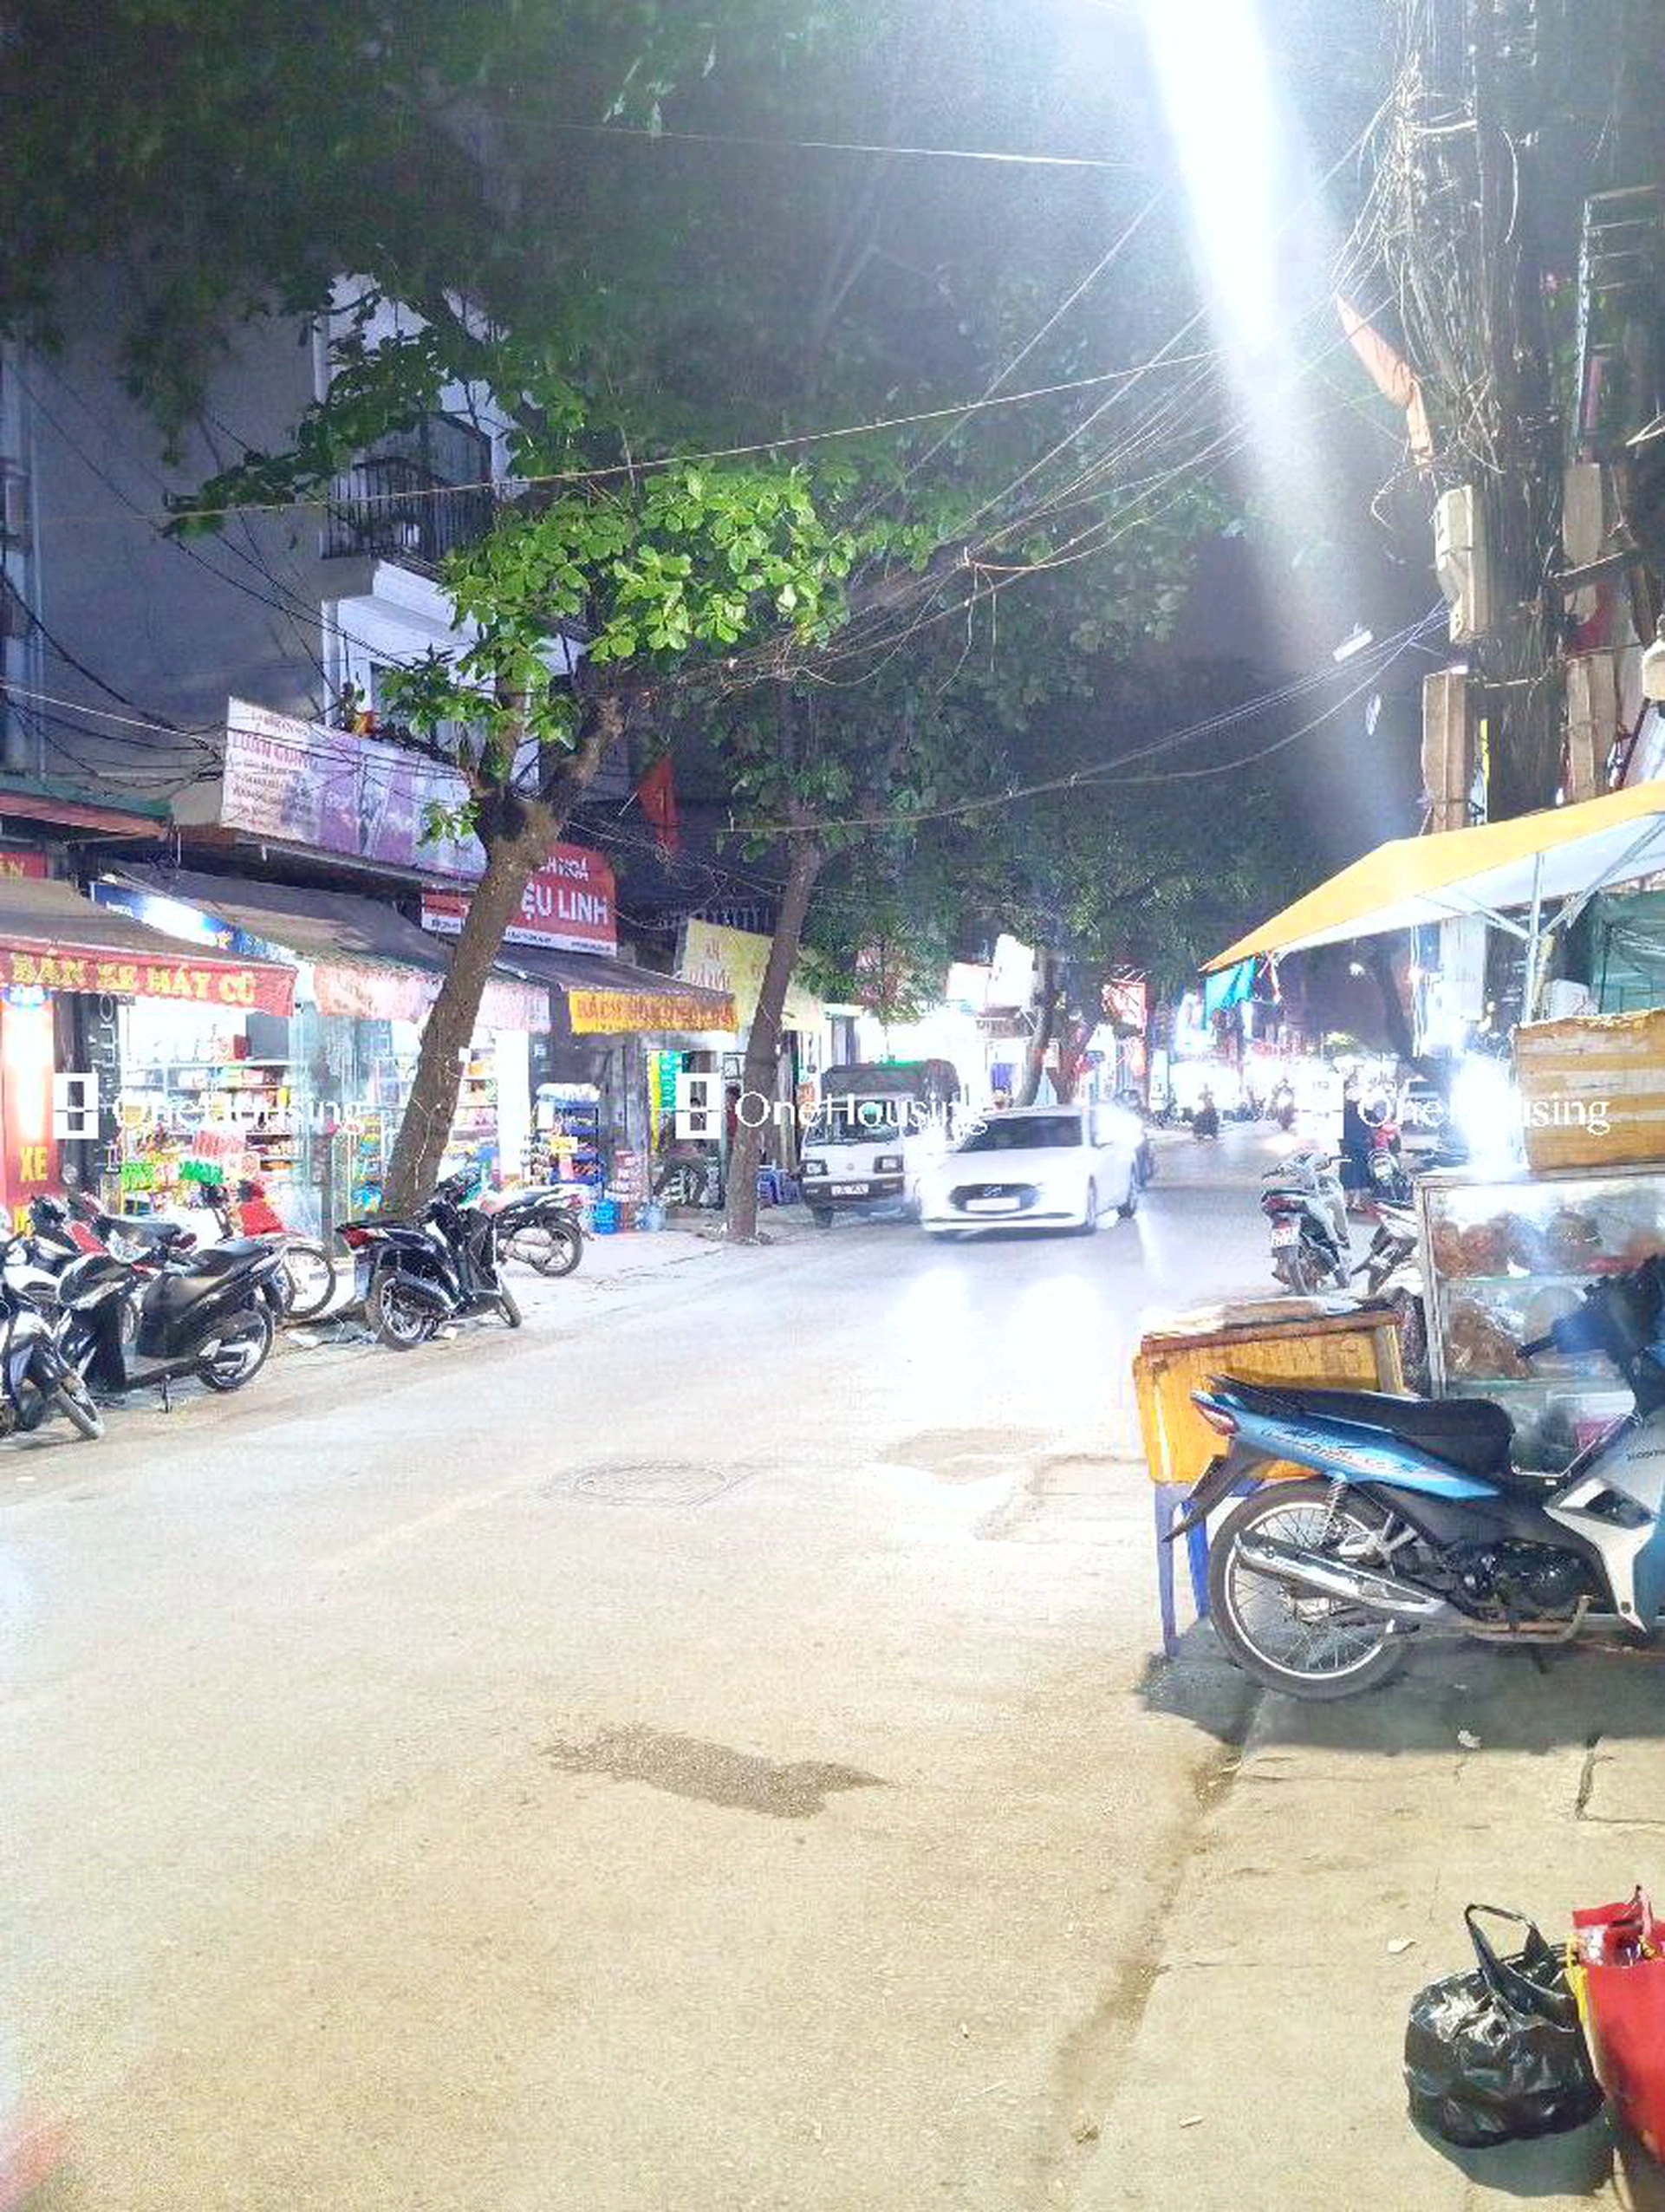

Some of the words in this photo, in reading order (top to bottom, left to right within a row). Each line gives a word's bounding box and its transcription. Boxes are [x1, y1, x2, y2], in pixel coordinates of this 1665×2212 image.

[521, 880, 554, 921] ỆU
[558, 888, 608, 926] LINH
[96, 955, 140, 991] XE
[146, 964, 211, 999] MÁY
[218, 970, 257, 1005] CŨ
[19, 1146, 49, 1181] XE
